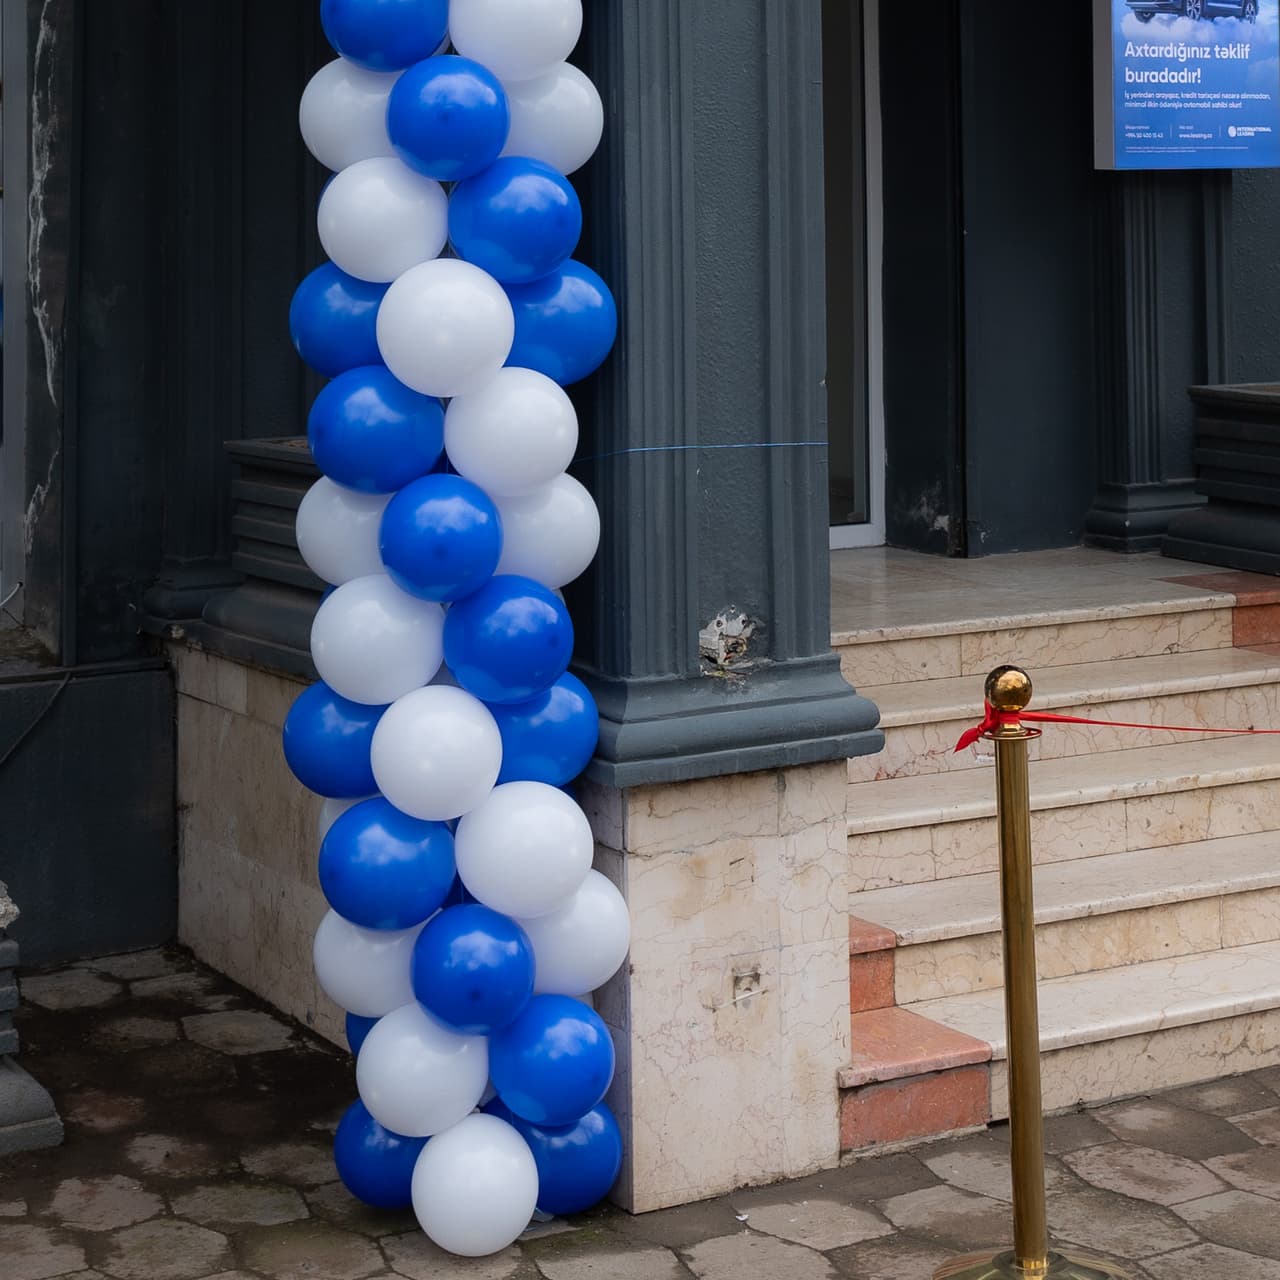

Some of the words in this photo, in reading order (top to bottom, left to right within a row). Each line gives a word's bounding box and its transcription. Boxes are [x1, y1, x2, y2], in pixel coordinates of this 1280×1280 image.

[1125, 41, 1211, 62] Axtardığınız
[1214, 43, 1251, 59] təklif
[1125, 67, 1202, 83] buradadır!
